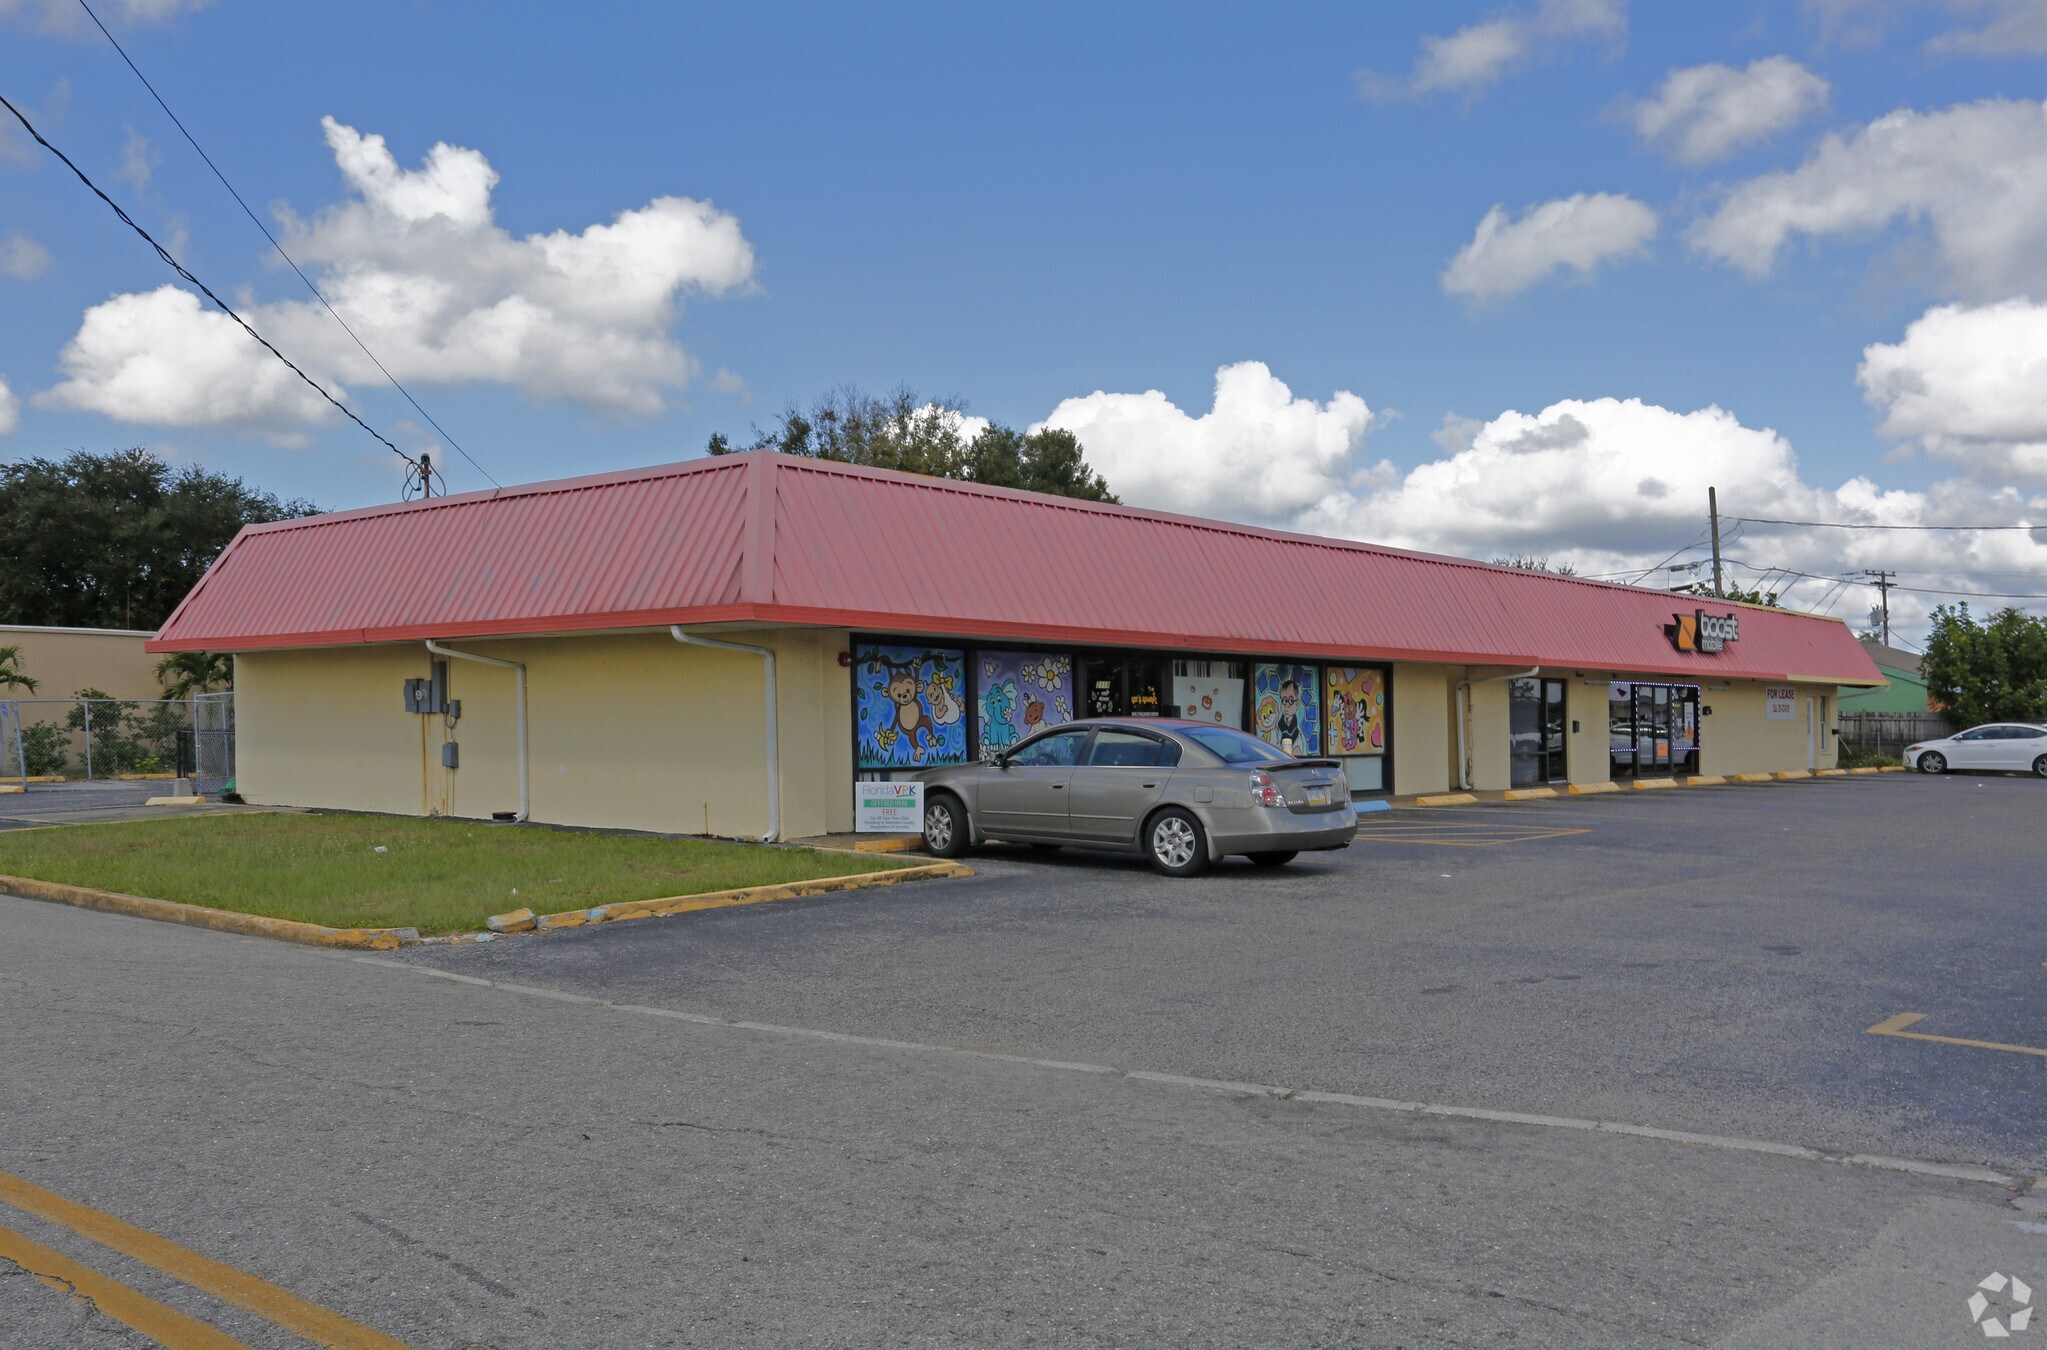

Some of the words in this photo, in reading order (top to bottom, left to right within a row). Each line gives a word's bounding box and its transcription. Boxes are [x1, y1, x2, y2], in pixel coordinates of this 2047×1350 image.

[1701, 611, 1739, 640] boost
[1702, 639, 1723, 651] mobile
[1767, 688, 1778, 700] FOR
[1779, 688, 1794, 700] LEASE
[870, 799, 894, 807] OFFERED
[894, 799, 908, 807] HERE
[882, 808, 897, 816] FREE
